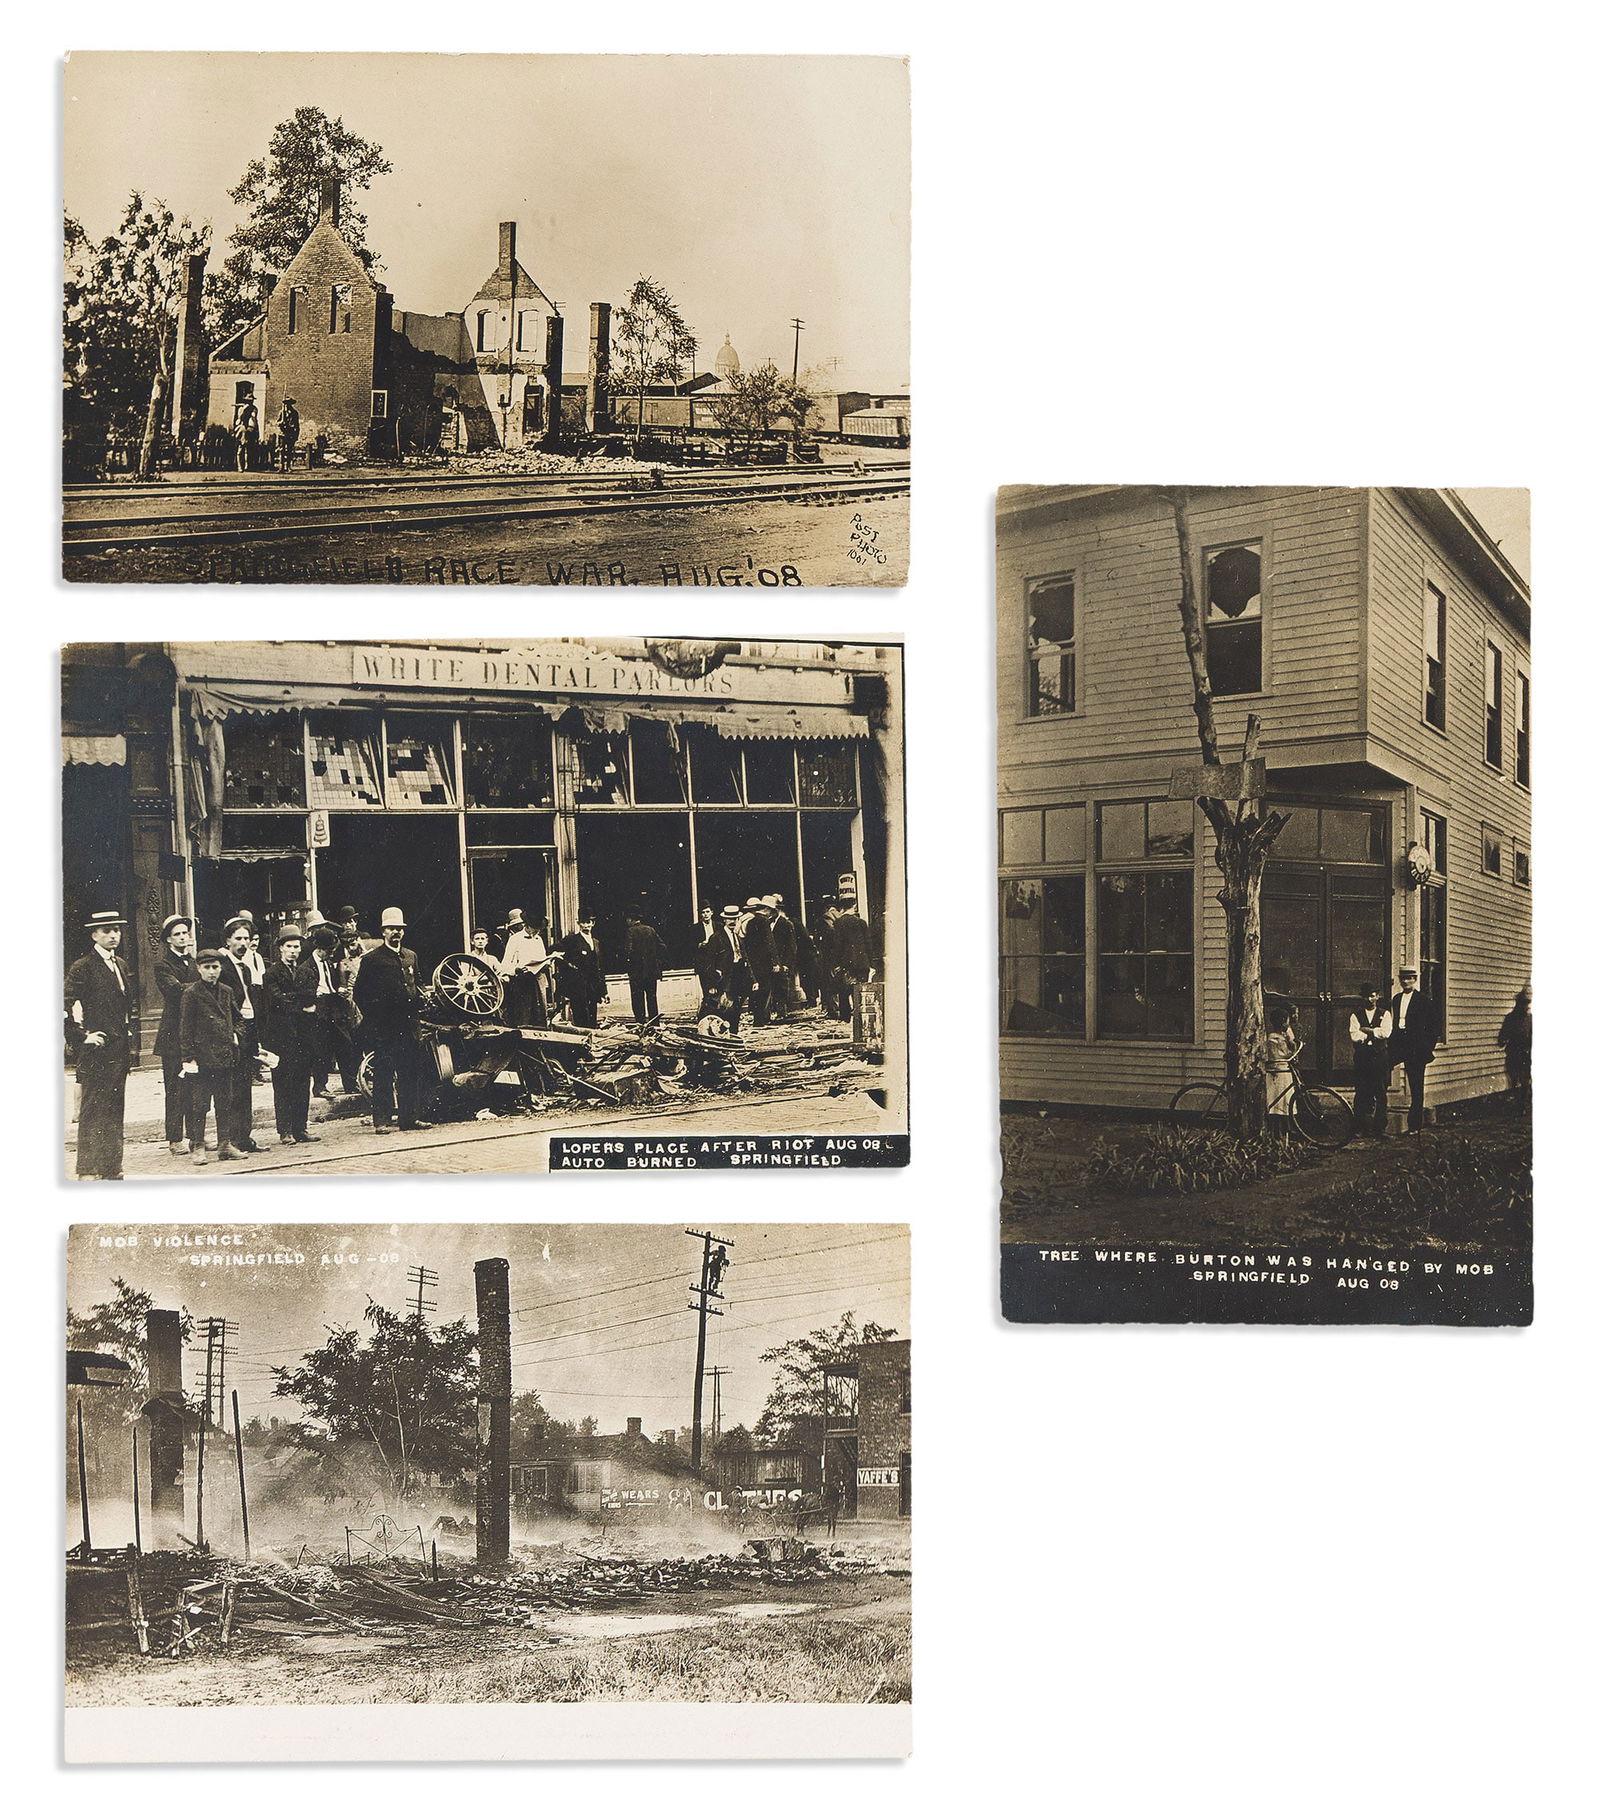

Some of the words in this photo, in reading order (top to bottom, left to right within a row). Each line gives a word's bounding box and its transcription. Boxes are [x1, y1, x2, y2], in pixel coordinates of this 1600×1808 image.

[362, 655, 464, 683] WHITE
[483, 661, 598, 689] DENTAL
[613, 667, 733, 695] PARLORS
[621, 1490, 660, 1500] WEARS
